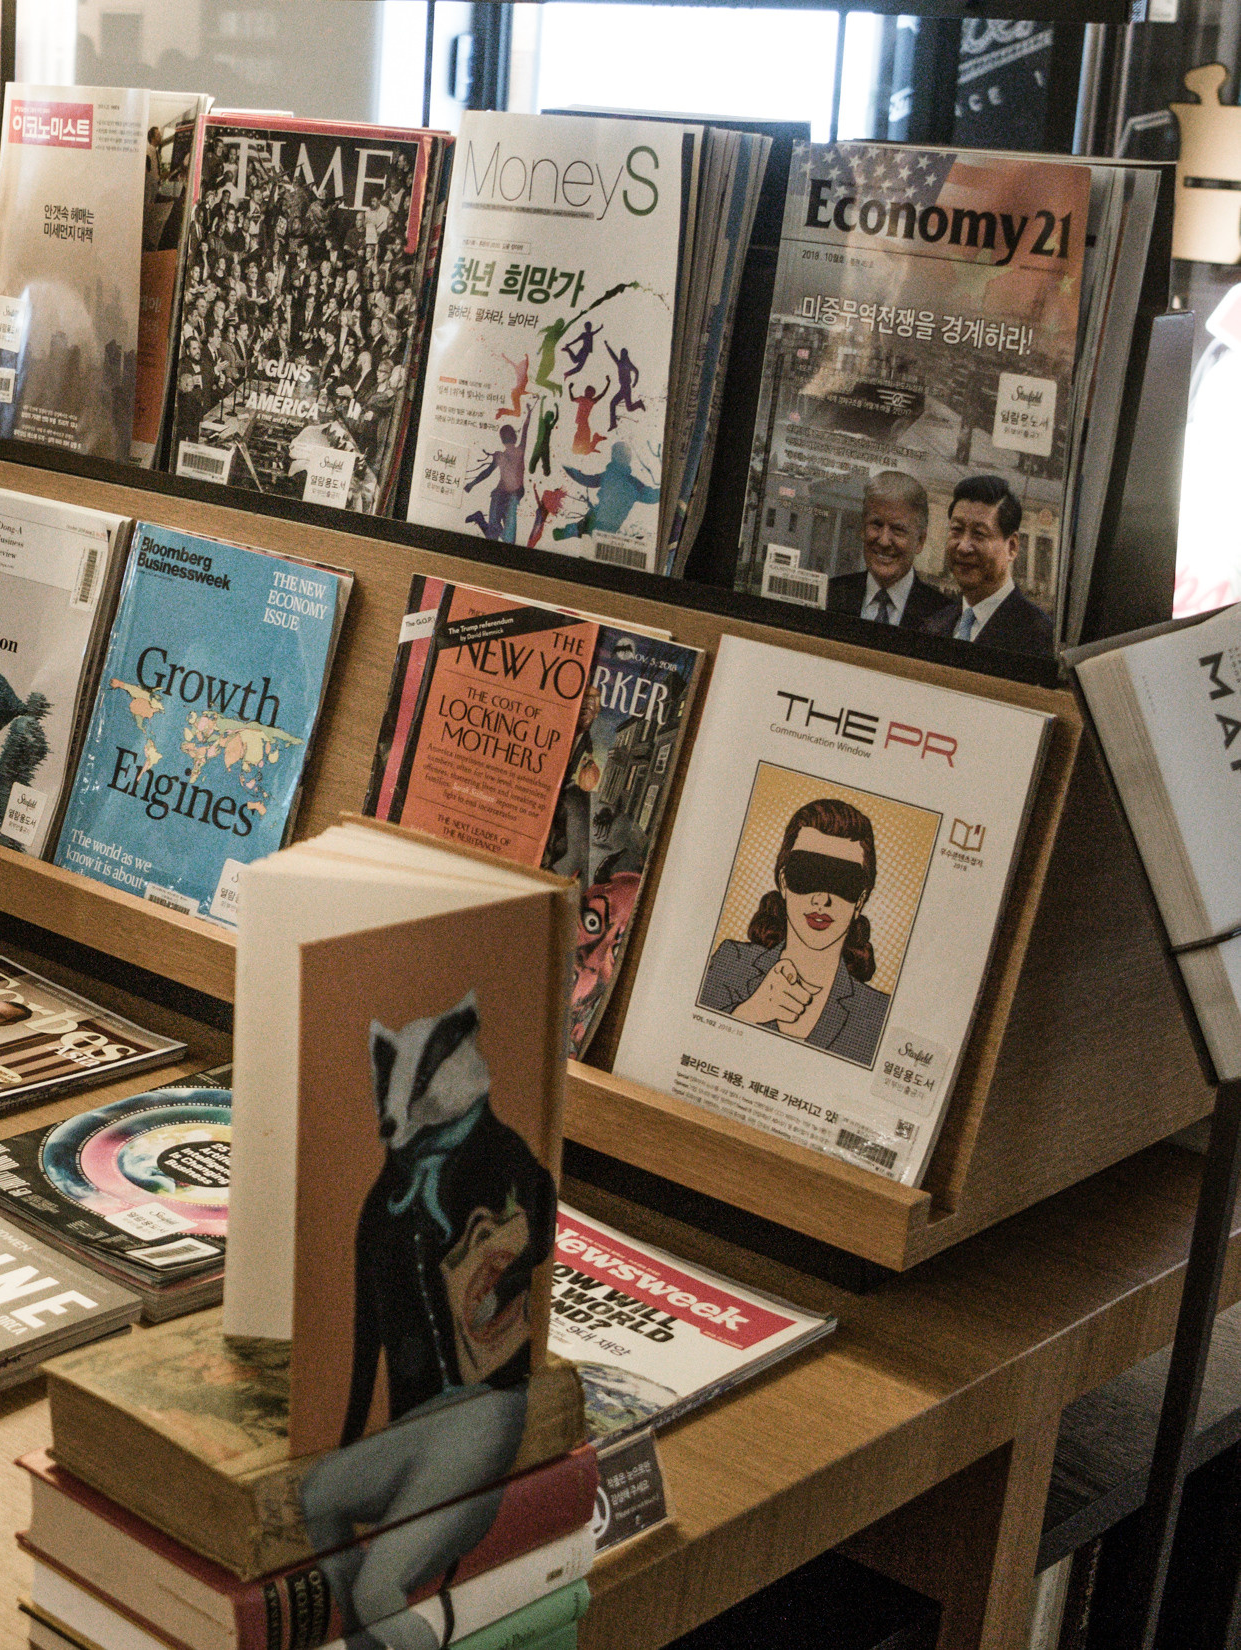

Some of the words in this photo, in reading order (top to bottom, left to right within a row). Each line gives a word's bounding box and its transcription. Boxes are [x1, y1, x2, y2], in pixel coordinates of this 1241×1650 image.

[12, 115, 91, 143] 이코노미스트
[219, 134, 394, 213] TIME
[460, 139, 660, 221] MoneyS
[44, 204, 70, 222] 안갯속
[70, 207, 95, 225] 헤매는
[804, 179, 1072, 268] Economy21
[43, 222, 76, 242] 미세먼지
[77, 227, 94, 244] 대책
[450, 256, 497, 298] 청년
[499, 263, 585, 308] 희망가
[447, 305, 472, 321] 말하라,
[507, 312, 539, 329] 날아라
[801, 295, 936, 341] 미중무역전쟁을
[939, 313, 1035, 356] 경계하라!
[265, 359, 312, 383] GUNS
[276, 378, 296, 398] IN
[245, 392, 320, 421] AMERICA
[140, 536, 213, 571] Bloomberg
[136, 554, 231, 592] Businessweek
[273, 571, 299, 592] THE
[299, 578, 327, 600] NEW
[262, 610, 300, 632] ISSUE
[266, 590, 329, 622] ECONOMY
[405, 619, 415, 628] The
[448, 626, 459, 636] The
[459, 622, 479, 635] Trump
[479, 616, 514, 631] referendum
[459, 634, 467, 644] by
[466, 631, 482, 642] David
[481, 627, 504, 640] Remnick
[552, 631, 586, 657] THE
[455, 640, 535, 681] NEW
[539, 652, 586, 700] YO
[135, 645, 282, 729] Growth
[465, 686, 488, 704] THE
[490, 692, 524, 714] COST
[524, 706, 542, 720] OF
[591, 664, 669, 726] RKER
[438, 693, 528, 742] LOCKING
[533, 721, 561, 750] UP
[775, 689, 880, 747] THE
[884, 721, 959, 769] PR
[441, 720, 548, 775] MOTHERS
[769, 722, 835, 750] Communication
[835, 738, 872, 760] Window
[107, 745, 257, 838] Engines
[437, 814, 450, 826] THE
[452, 819, 470, 832] NEXT
[471, 824, 499, 842] LEADER
[442, 826, 455, 838] THE
[71, 828, 92, 850] The
[92, 842, 122, 862] world
[121, 851, 134, 867] as
[134, 856, 153, 874] we
[65, 845, 93, 869] know
[94, 856, 104, 873] it
[103, 860, 113, 878] is
[112, 866, 145, 891] about
[45, 1043, 102, 1068] Asia
[897, 1041, 934, 1068] Starfield
[679, 1053, 721, 1080] 블라인드
[721, 1066, 746, 1090] 채용,
[747, 1079, 780, 1102] 제대로
[781, 1092, 822, 1119] 가려지고
[882, 1060, 937, 1092] 열람용도서
[164, 1158, 214, 1186] Business
[181, 1156, 232, 1186] Changing
[559, 1289, 676, 1344] WORLD
[602, 1282, 679, 1331] WILL
[565, 1325, 597, 1343] 9대
[595, 1336, 632, 1358] 재앙
